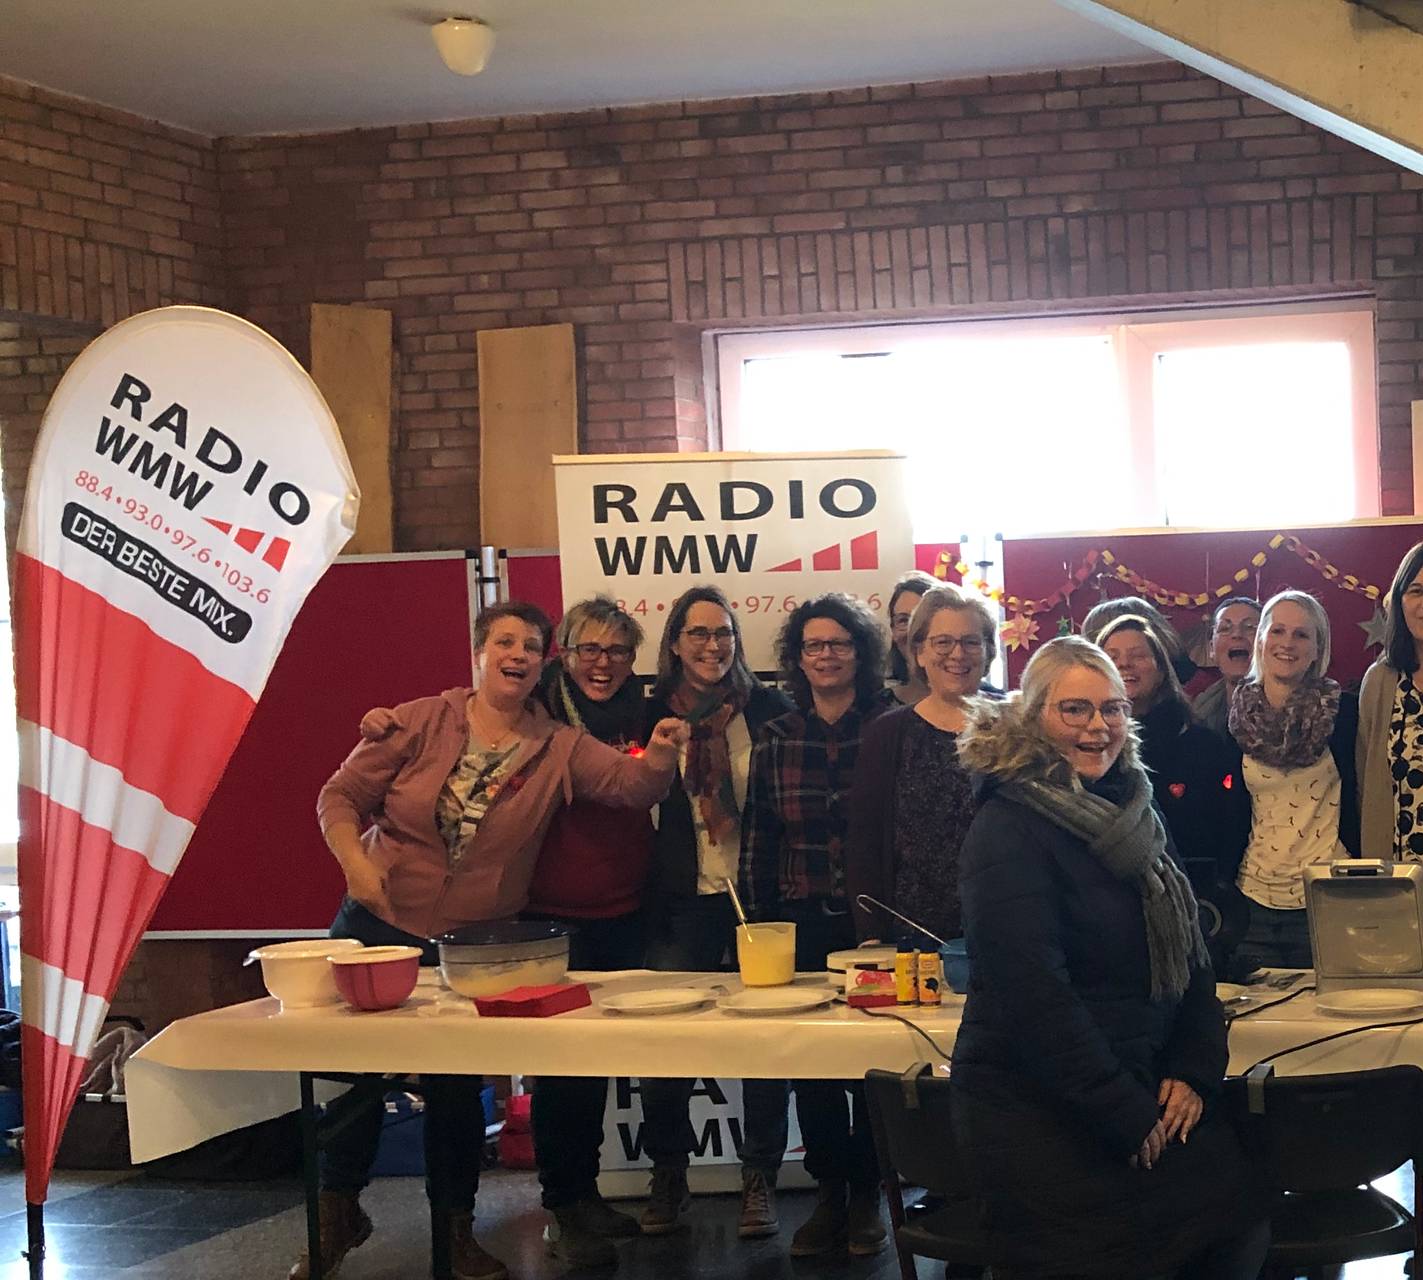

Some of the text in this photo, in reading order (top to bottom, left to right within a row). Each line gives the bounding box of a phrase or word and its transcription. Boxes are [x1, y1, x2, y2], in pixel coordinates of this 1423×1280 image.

[95, 416, 214, 511] WMW
[110, 373, 311, 526] RADIO
[75, 470, 272, 604] 88.4 93.0 97.6 103.6
[592, 478, 877, 524] RADIO
[70, 512, 236, 636] DER BESTE MIX.
[594, 533, 758, 576] WMW
[745, 595, 798, 614] 97.6
